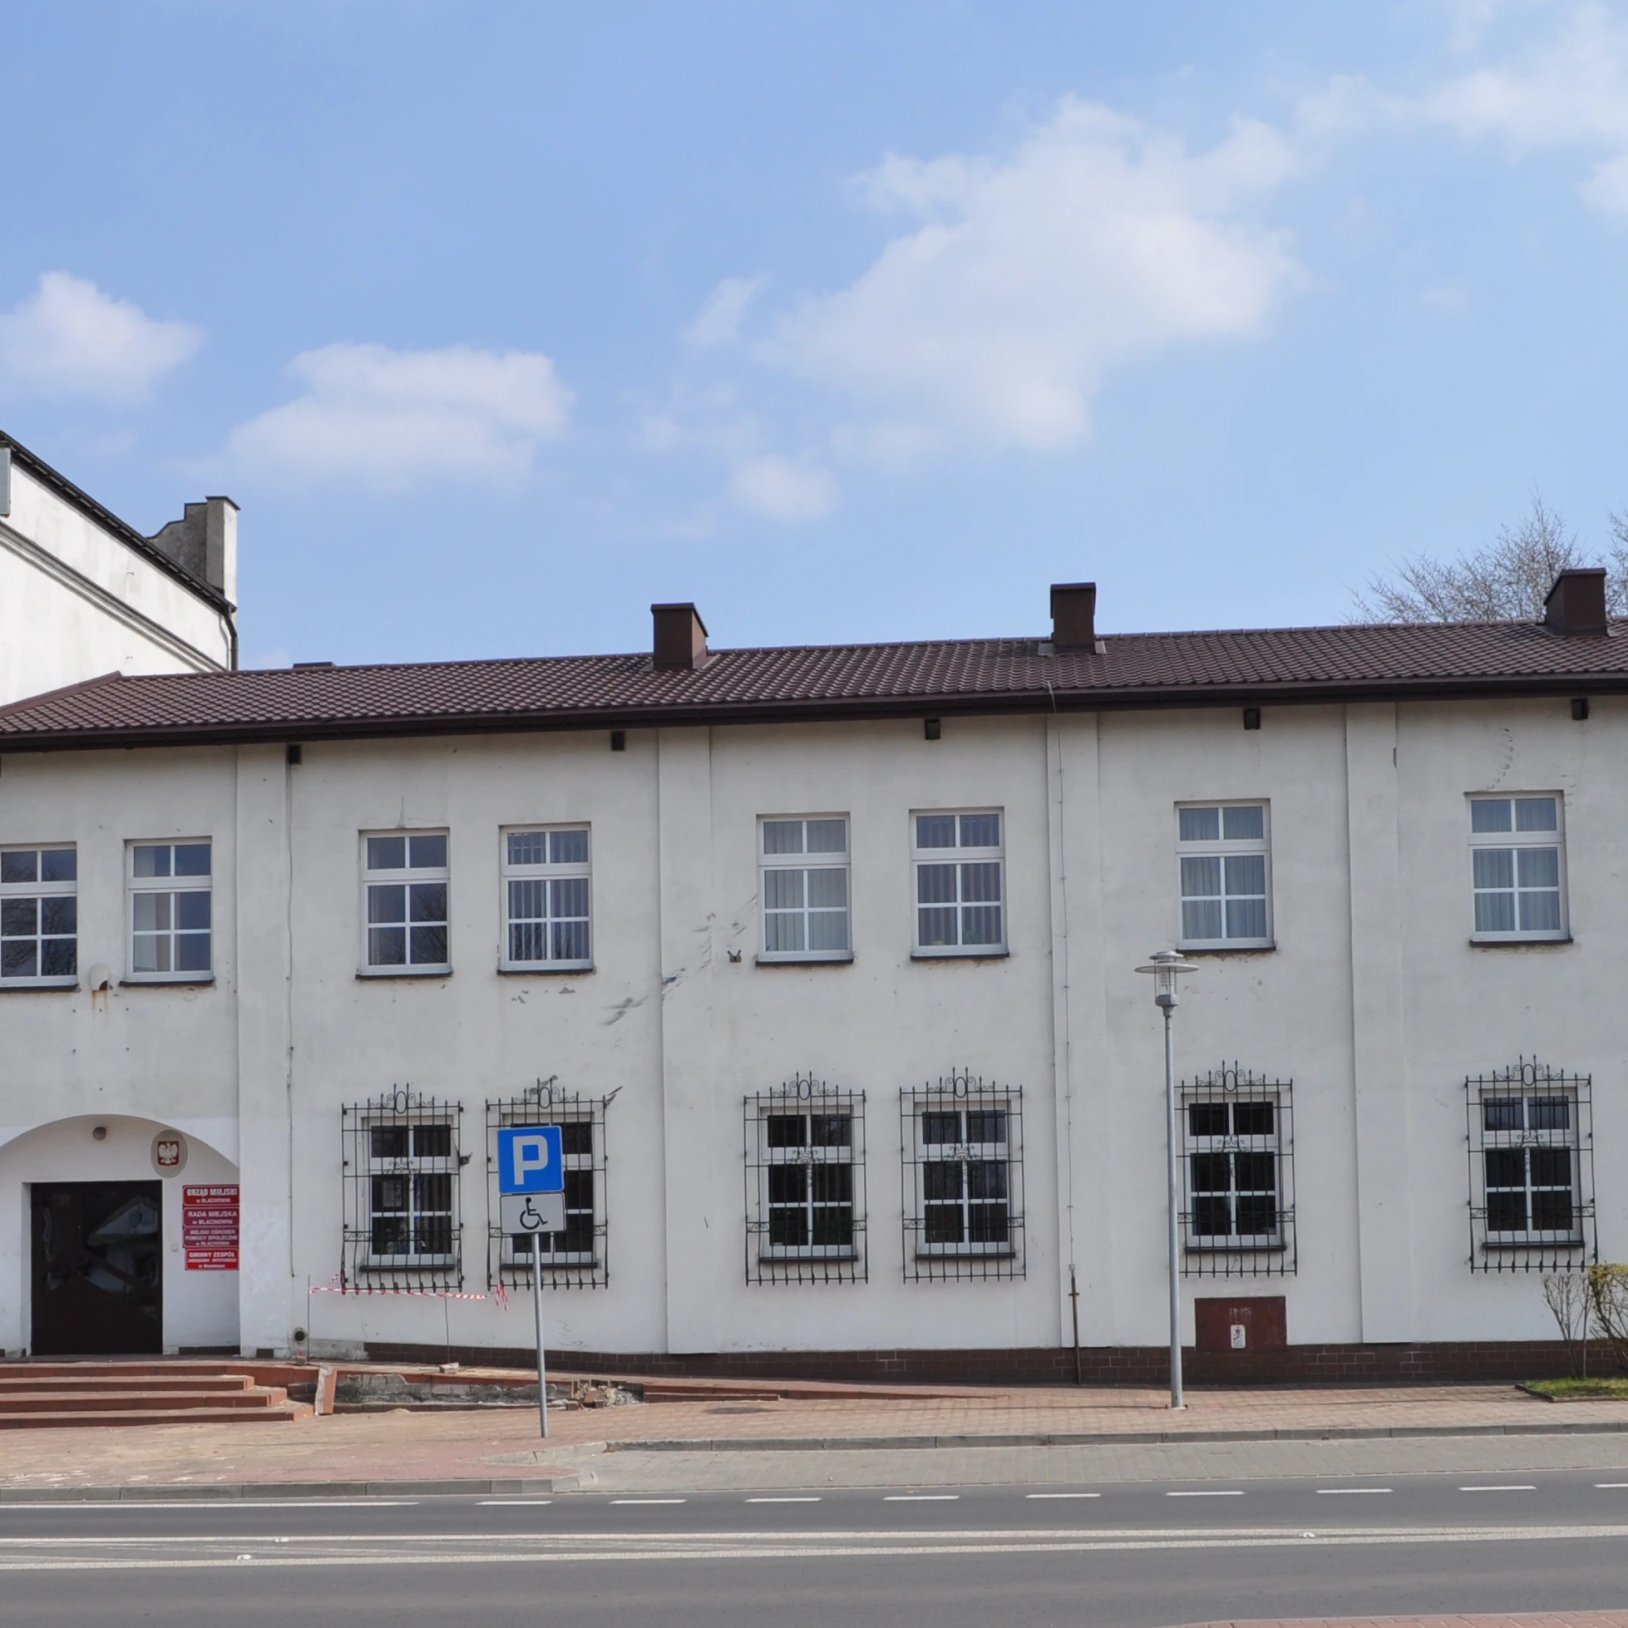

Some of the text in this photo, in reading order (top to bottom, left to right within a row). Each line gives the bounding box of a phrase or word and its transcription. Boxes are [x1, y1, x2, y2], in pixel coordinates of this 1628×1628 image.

[512, 1134, 549, 1186] P
[187, 1187, 237, 1197] URZĄD MIEJSKI
